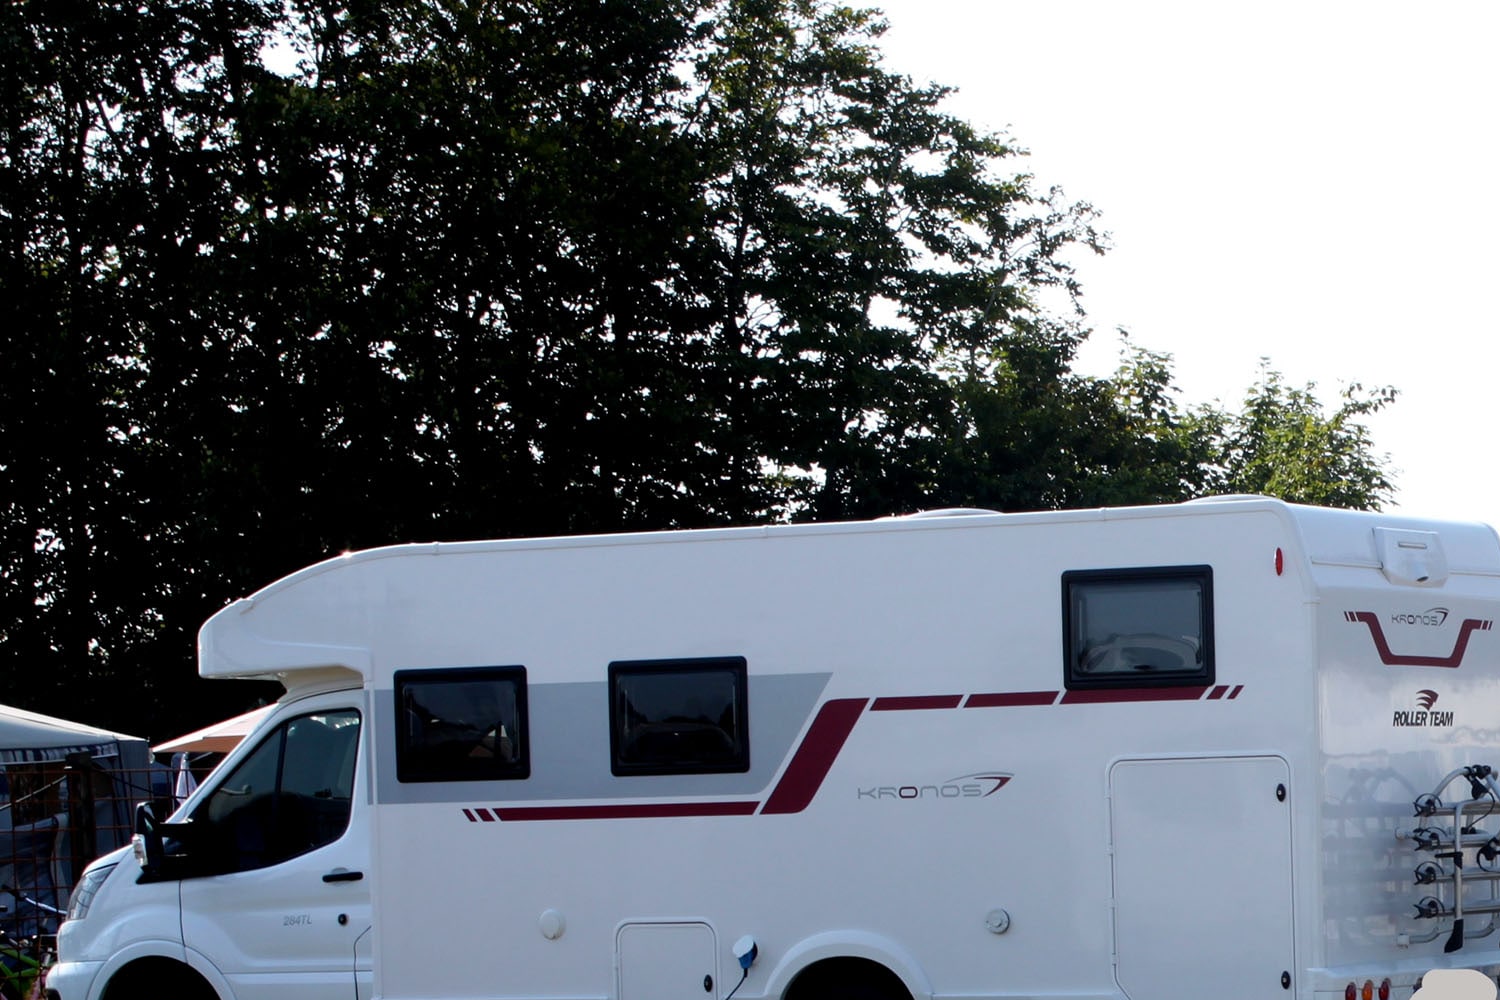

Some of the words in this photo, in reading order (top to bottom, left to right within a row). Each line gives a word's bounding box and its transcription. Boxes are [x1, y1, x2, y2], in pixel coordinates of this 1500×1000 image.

[1391, 614, 1438, 626] KRONOS
[1393, 711, 1427, 727] ROLLER
[1429, 711, 1454, 727] TEAM
[857, 784, 982, 800] KRONOS
